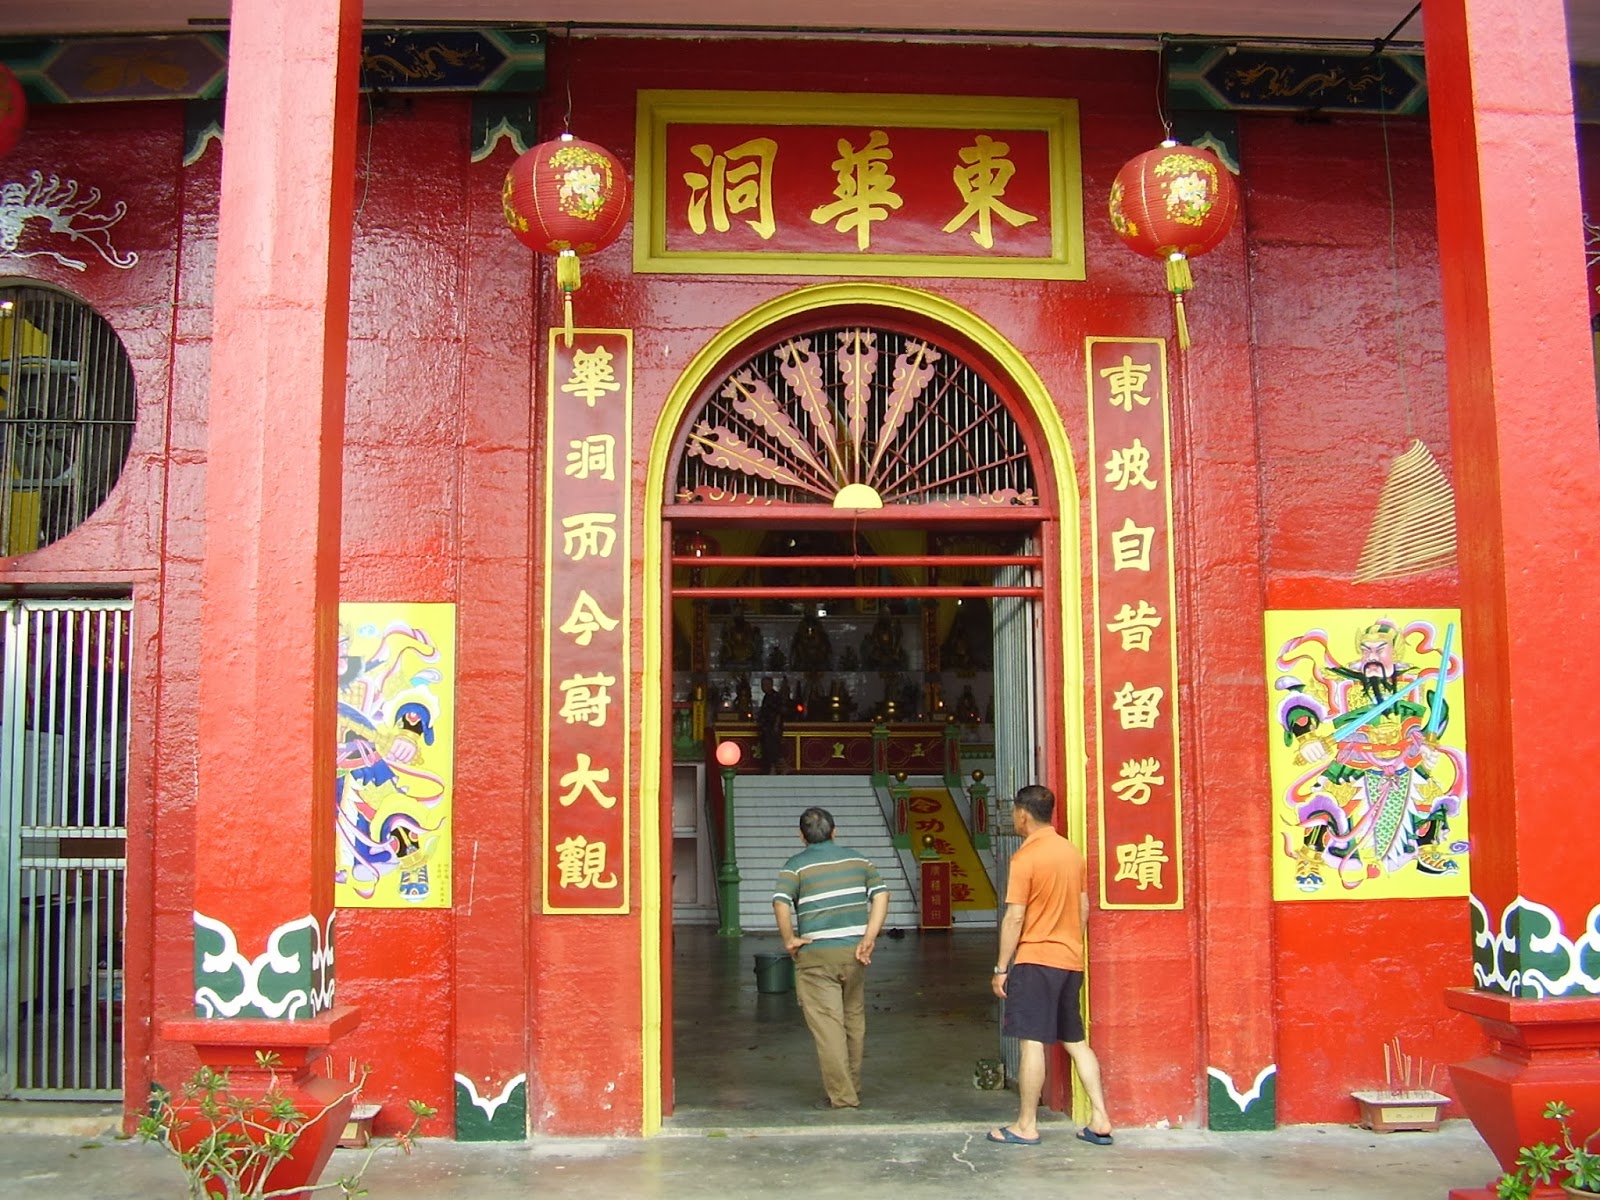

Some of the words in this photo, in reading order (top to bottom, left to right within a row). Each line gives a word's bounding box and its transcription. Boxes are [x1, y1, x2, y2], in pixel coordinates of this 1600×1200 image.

[556, 345, 622, 890] 華洞而今蔚大觀
[1099, 355, 1169, 891] 東坡自昔留芳蹟
